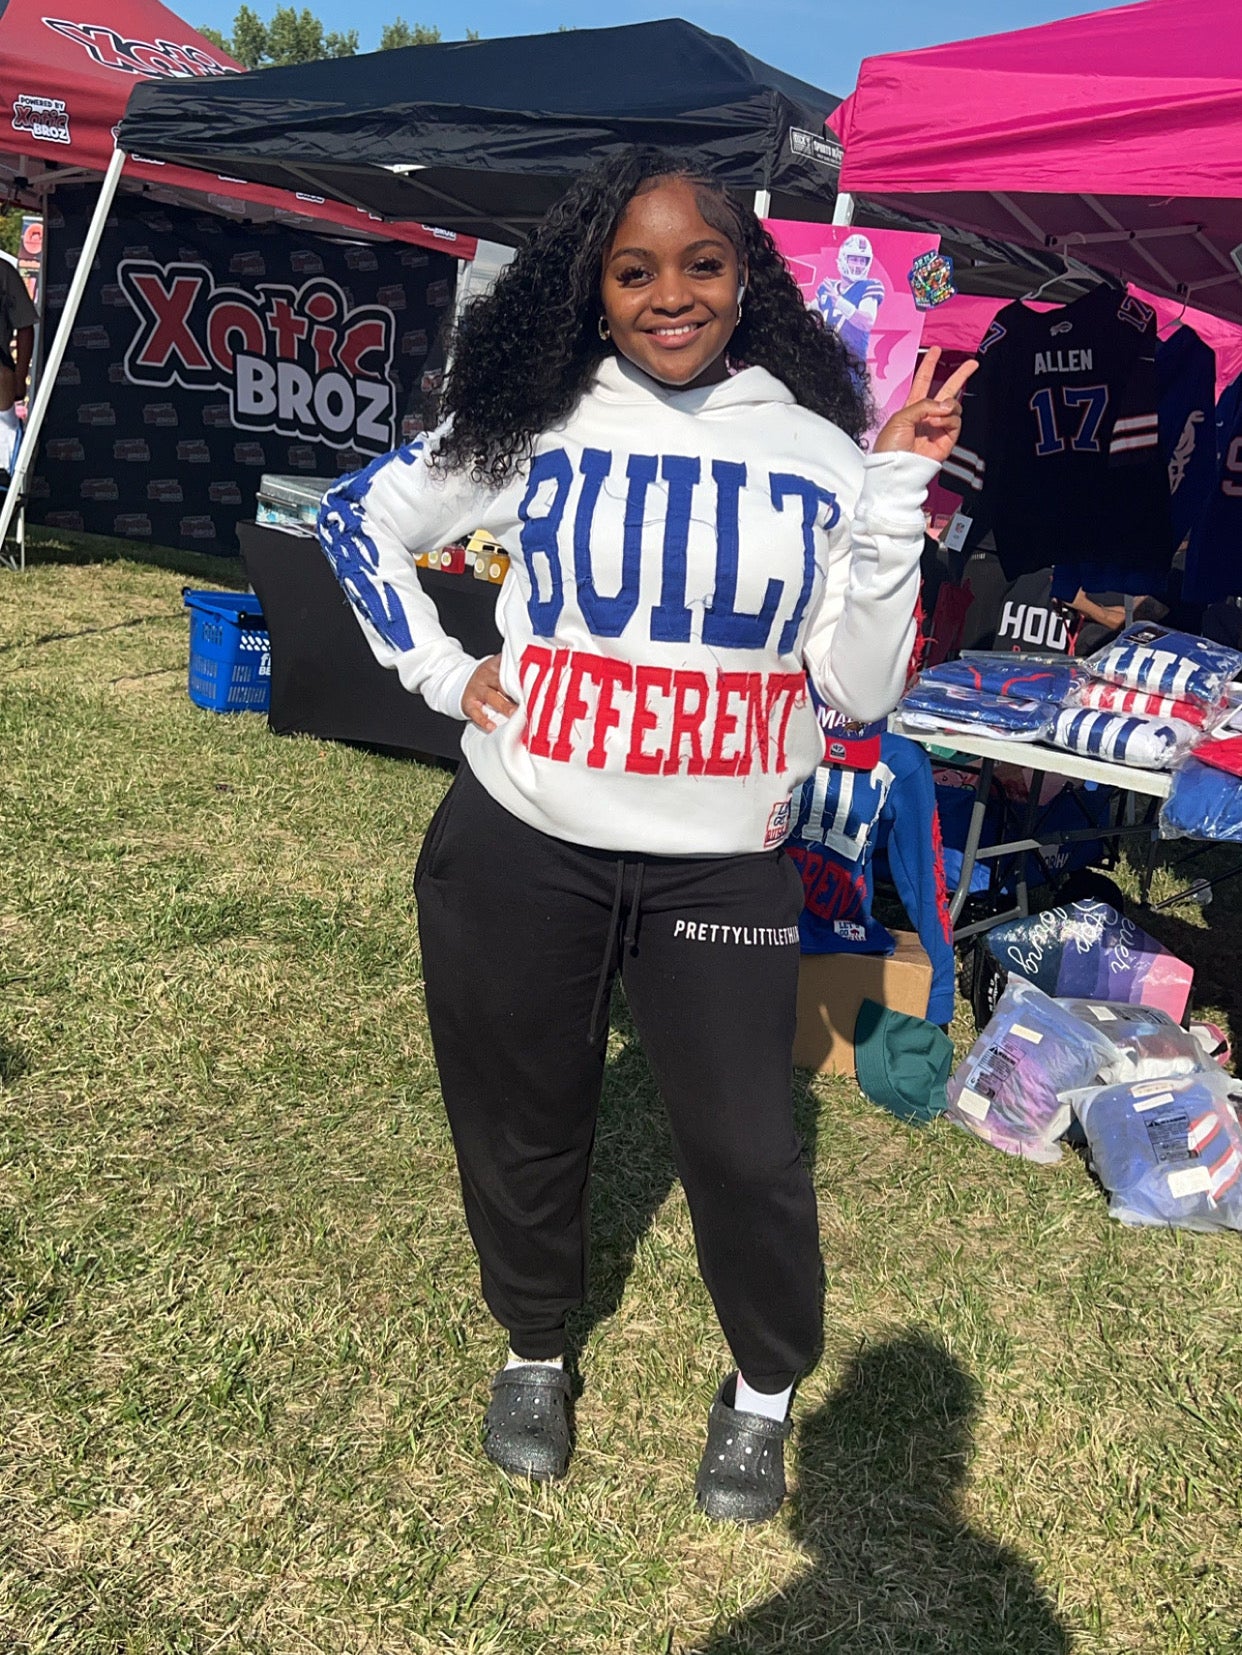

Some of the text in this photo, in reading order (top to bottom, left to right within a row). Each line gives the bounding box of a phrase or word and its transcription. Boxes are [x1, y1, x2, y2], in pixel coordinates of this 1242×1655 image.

[14, 104, 67, 128] Xotic
[20, 97, 64, 110] POWERED BY
[33, 122, 69, 141] BROZ
[128, 270, 387, 378] Xotic
[1117, 295, 1154, 333] 17
[978, 323, 1007, 354] 7
[1034, 349, 1093, 375] ALLEN
[234, 353, 391, 444] BROZ
[1029, 384, 1109, 456] 17
[518, 447, 841, 656] BUILT
[519, 644, 807, 777] DIFFERENT
[674, 920, 799, 947] PRETTYLITTLETHIN
[1110, 917, 1136, 973] ever
